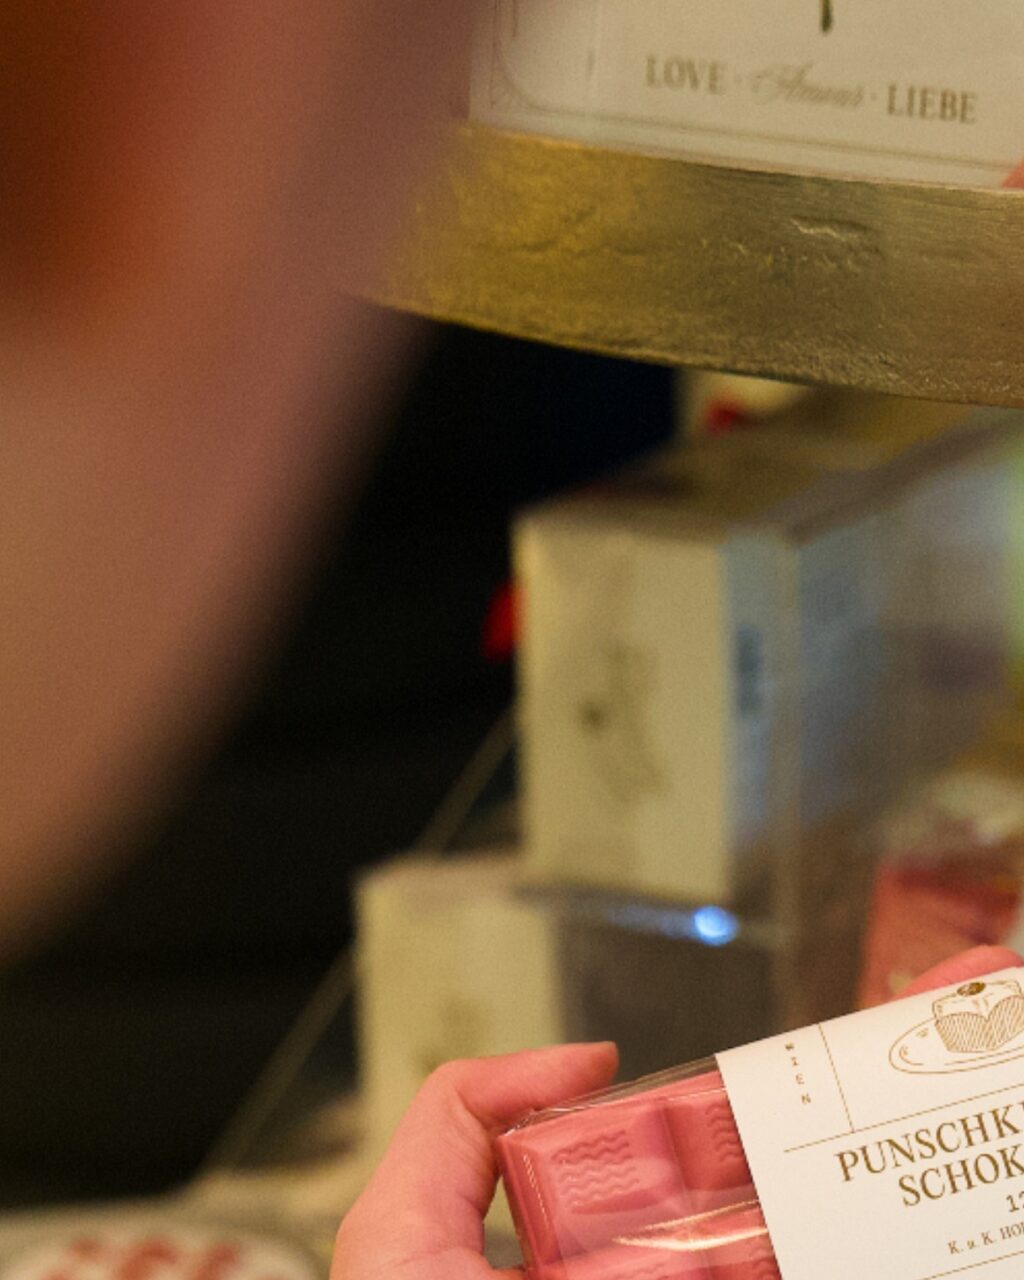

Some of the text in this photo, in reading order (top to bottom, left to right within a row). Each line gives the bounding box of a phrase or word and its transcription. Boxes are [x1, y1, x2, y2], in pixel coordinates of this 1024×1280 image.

[645, 55, 726, 95] LOVE
[886, 82, 977, 125] LIEBE
[784, 1042, 812, 1106] WIEN
